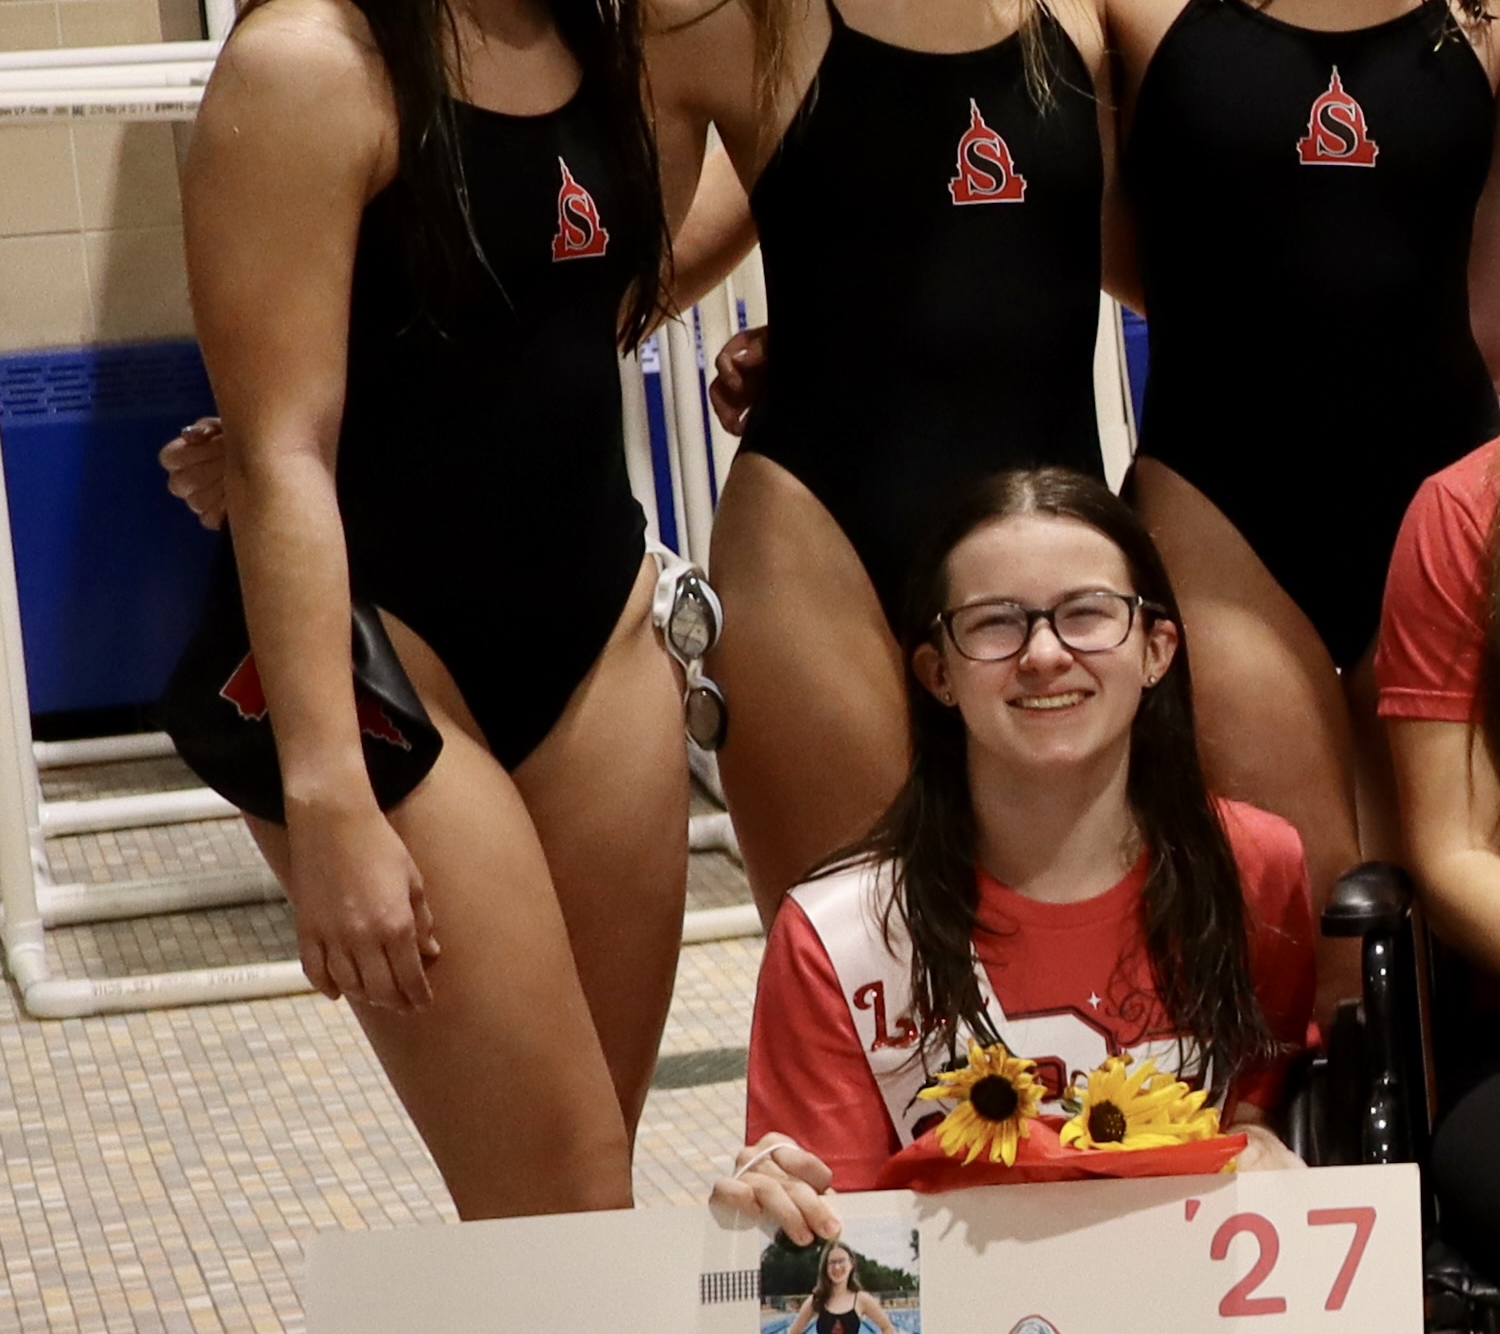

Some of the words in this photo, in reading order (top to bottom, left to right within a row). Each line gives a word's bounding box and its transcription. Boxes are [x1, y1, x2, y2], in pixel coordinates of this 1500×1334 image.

[1316, 101, 1359, 157] S
[963, 136, 1007, 196] S
[562, 193, 595, 252] S
[1183, 1197, 1377, 1319] '27
